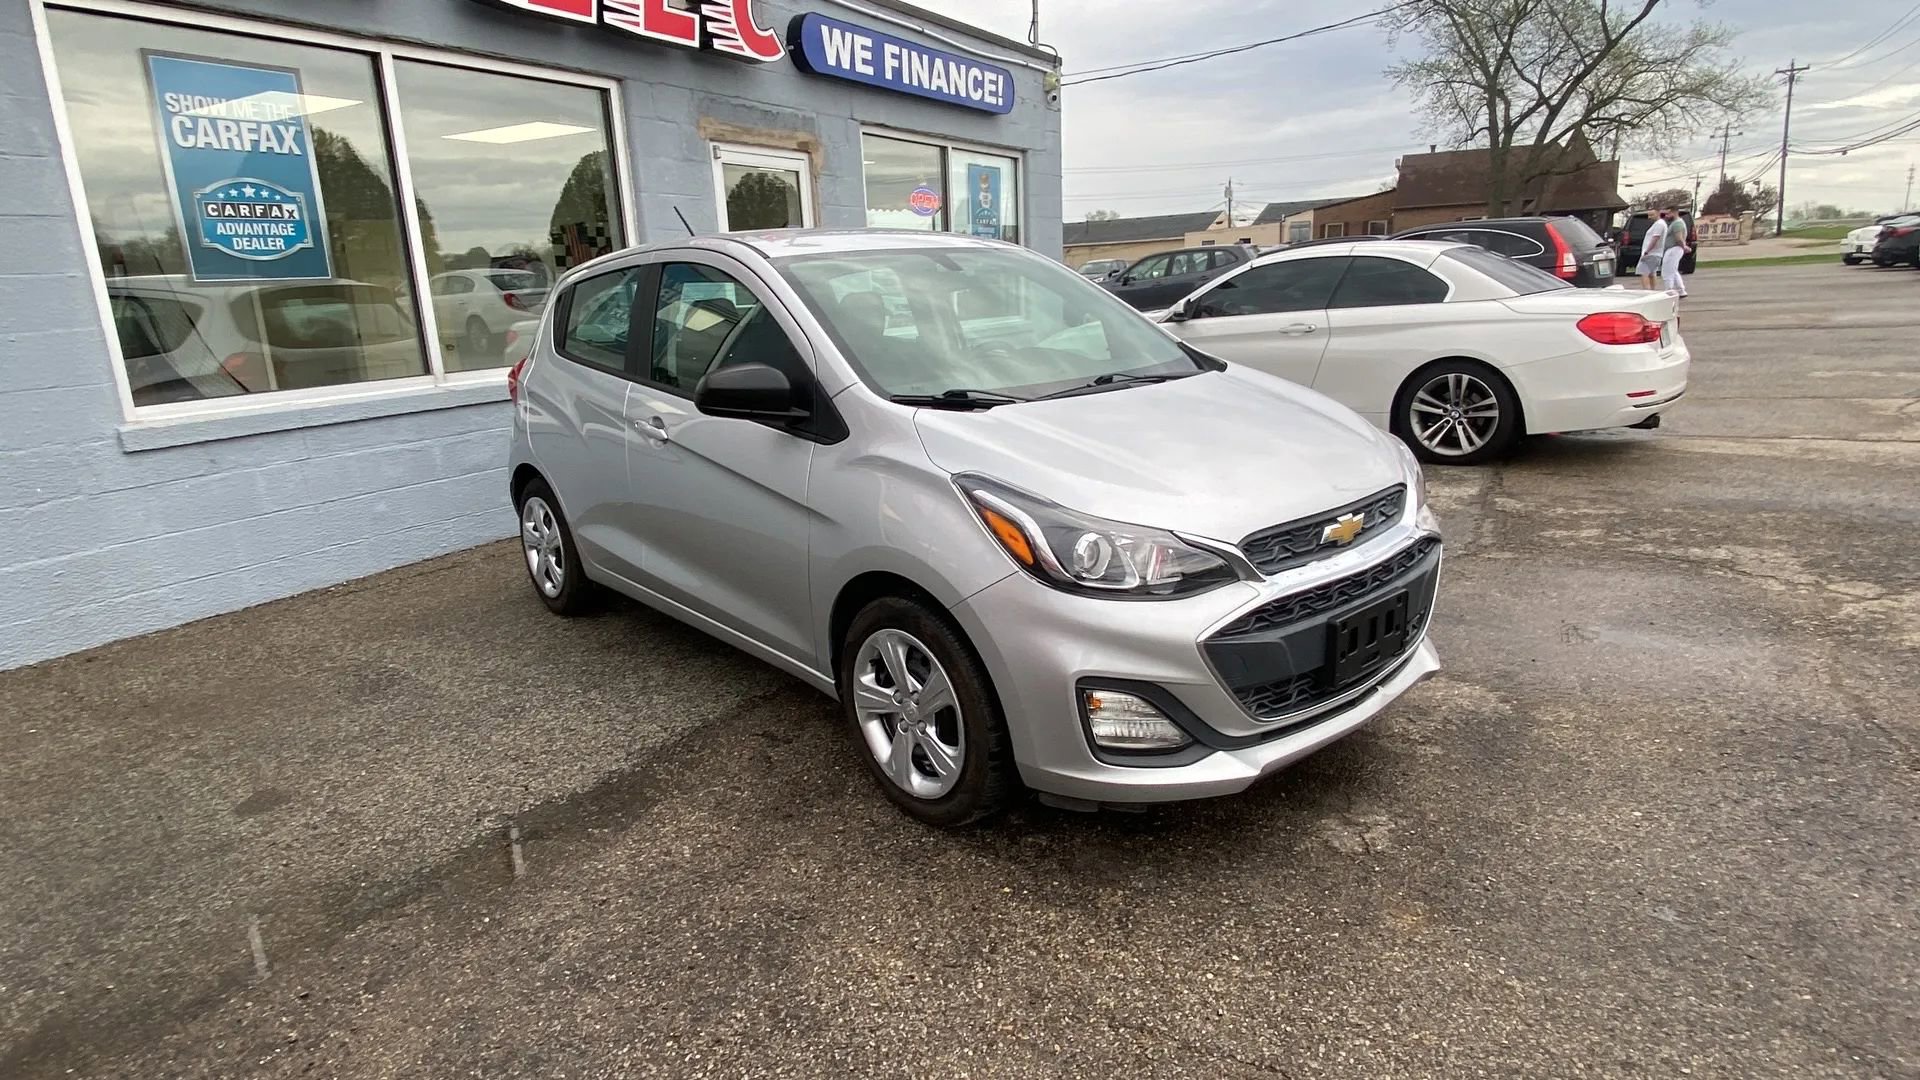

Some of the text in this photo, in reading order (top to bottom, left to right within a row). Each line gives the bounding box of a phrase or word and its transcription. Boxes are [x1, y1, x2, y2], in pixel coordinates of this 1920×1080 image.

[820, 24, 875, 76] WE
[883, 42, 1004, 106] FINANCE!
[164, 92, 297, 124] SHOW ME THE
[171, 115, 302, 156] CARFAX
[910, 191, 940, 209] OPEN
[206, 203, 297, 220] CARFAX
[216, 222, 296, 236] ADVANTAGE
[232, 237, 286, 251] DEALER
